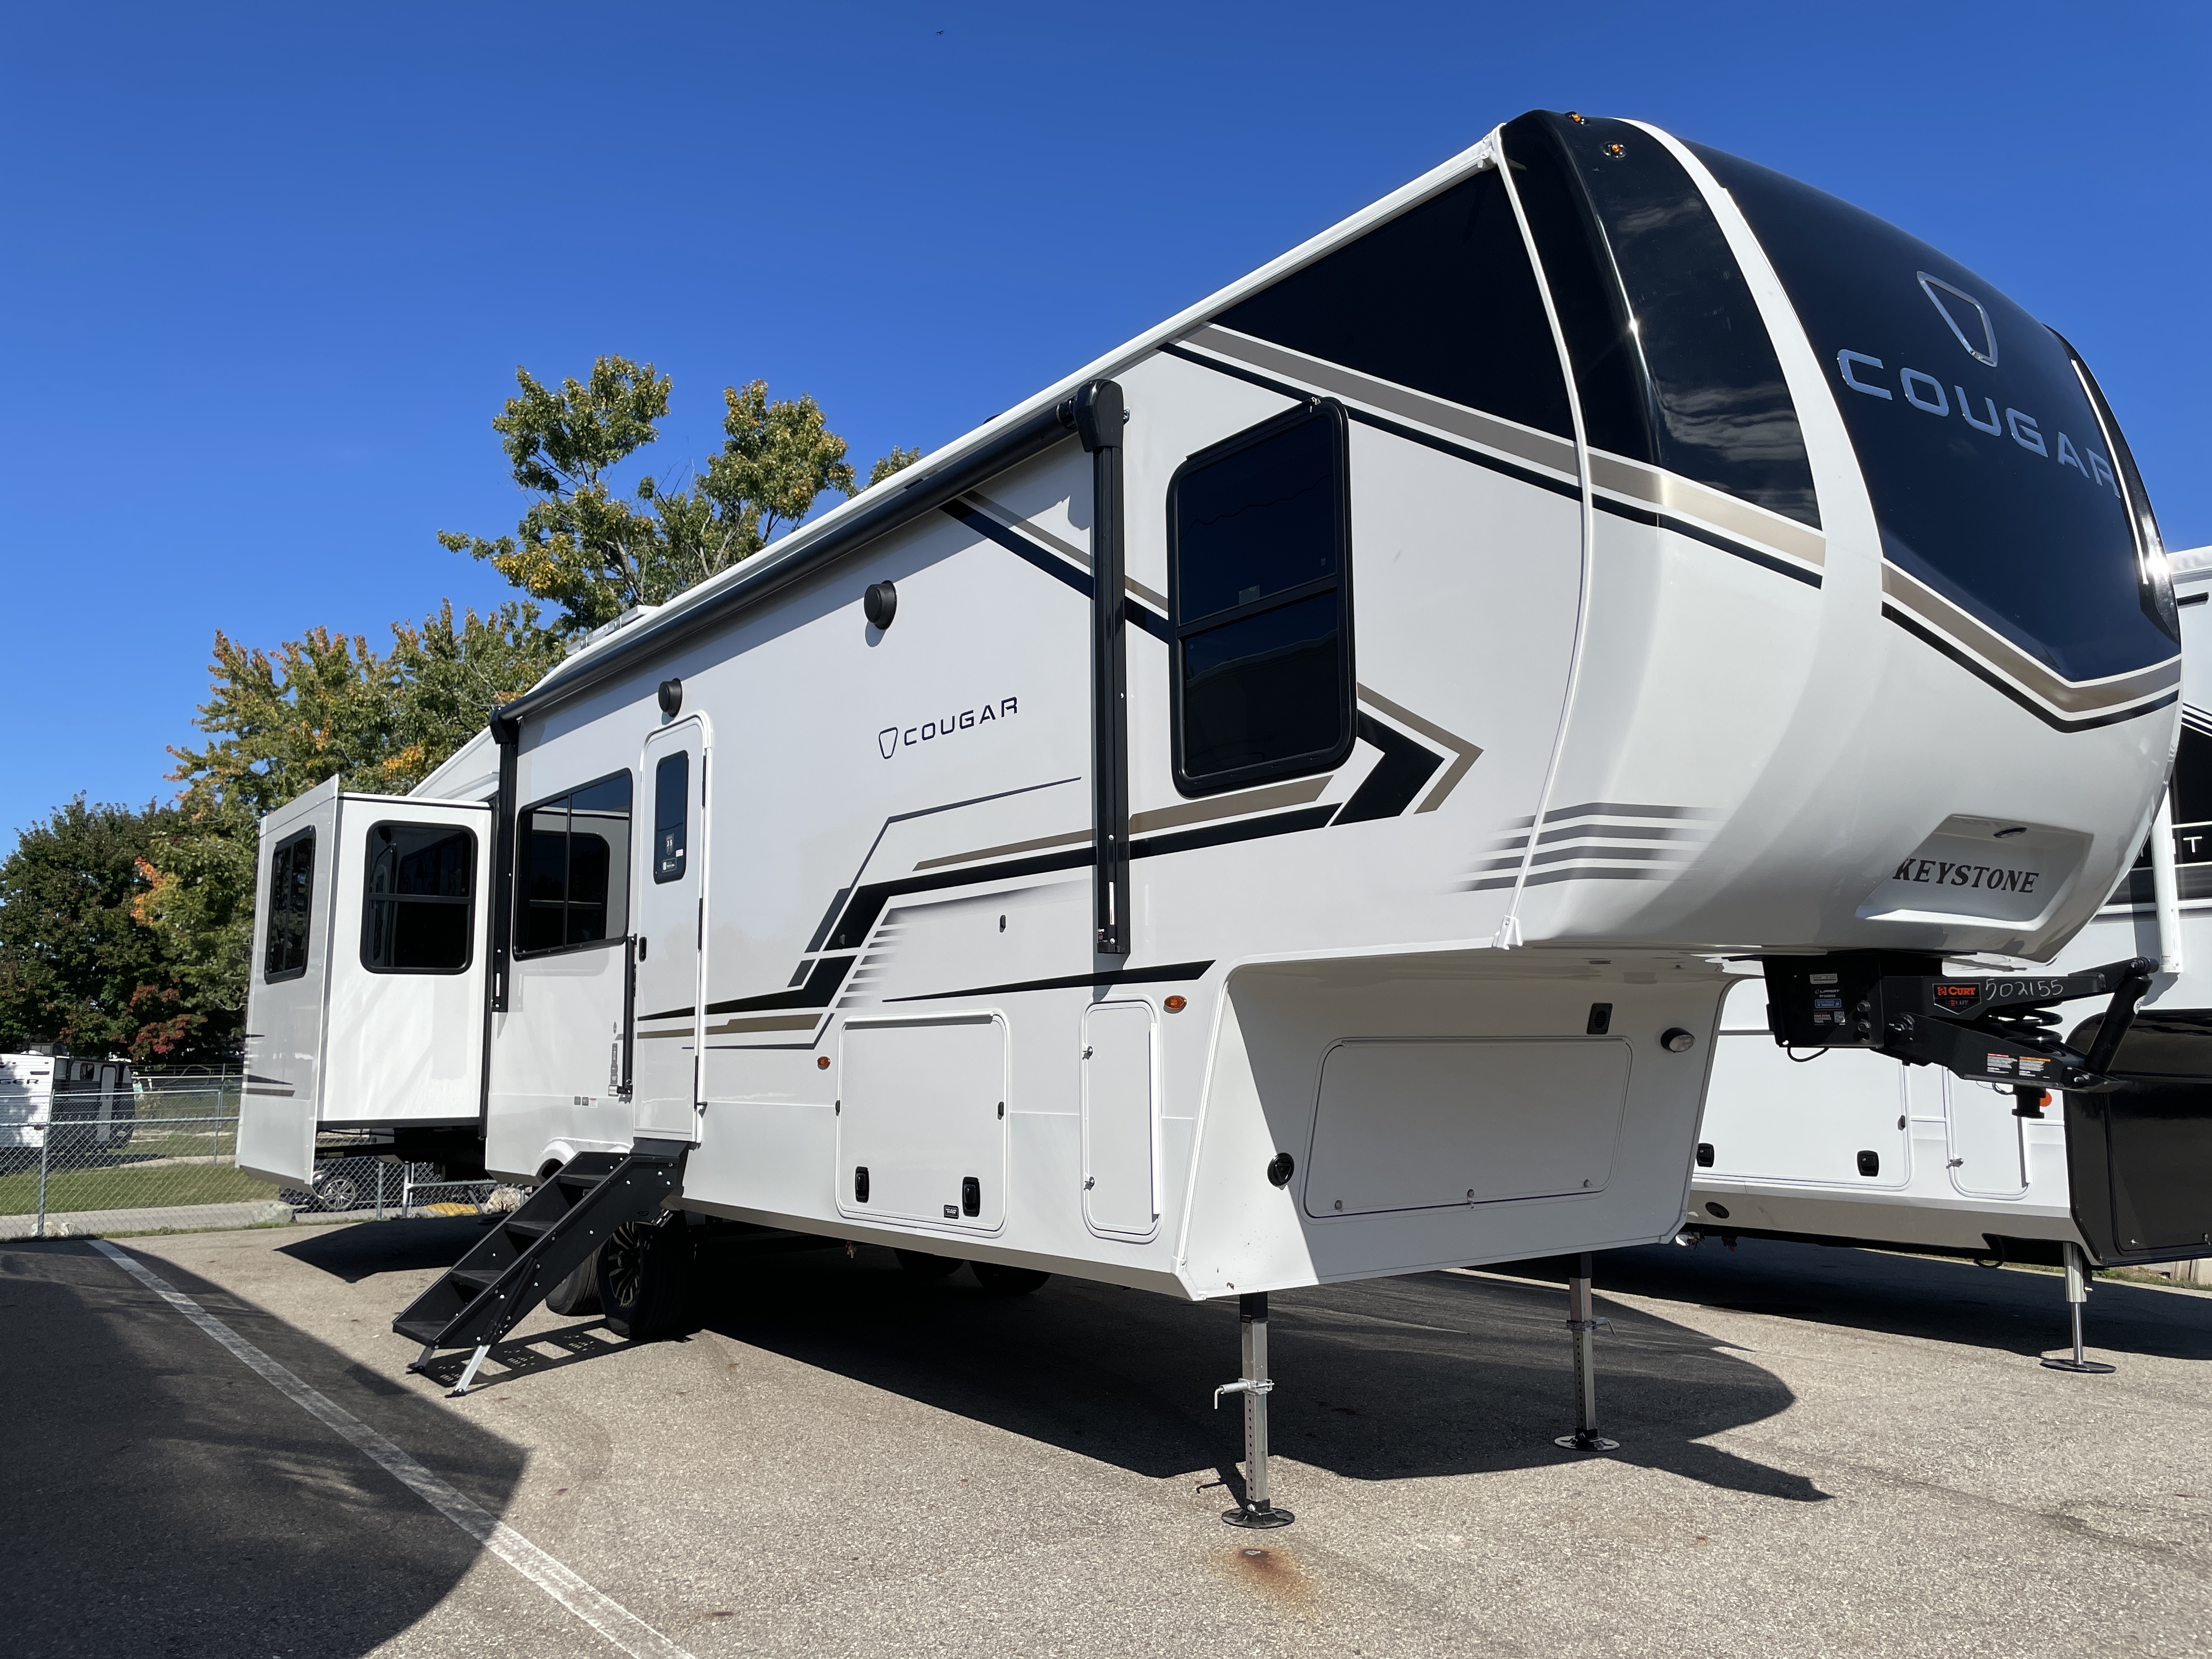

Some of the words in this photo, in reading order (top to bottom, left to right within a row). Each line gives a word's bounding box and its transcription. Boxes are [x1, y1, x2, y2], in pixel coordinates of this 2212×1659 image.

[1836, 348, 2121, 498] COUGAR
[904, 696, 1018, 746] COUGAR
[1892, 858, 2039, 893] KEYSTONE
[1948, 986, 1976, 996] CURT
[1985, 978, 2064, 1001] 502155
